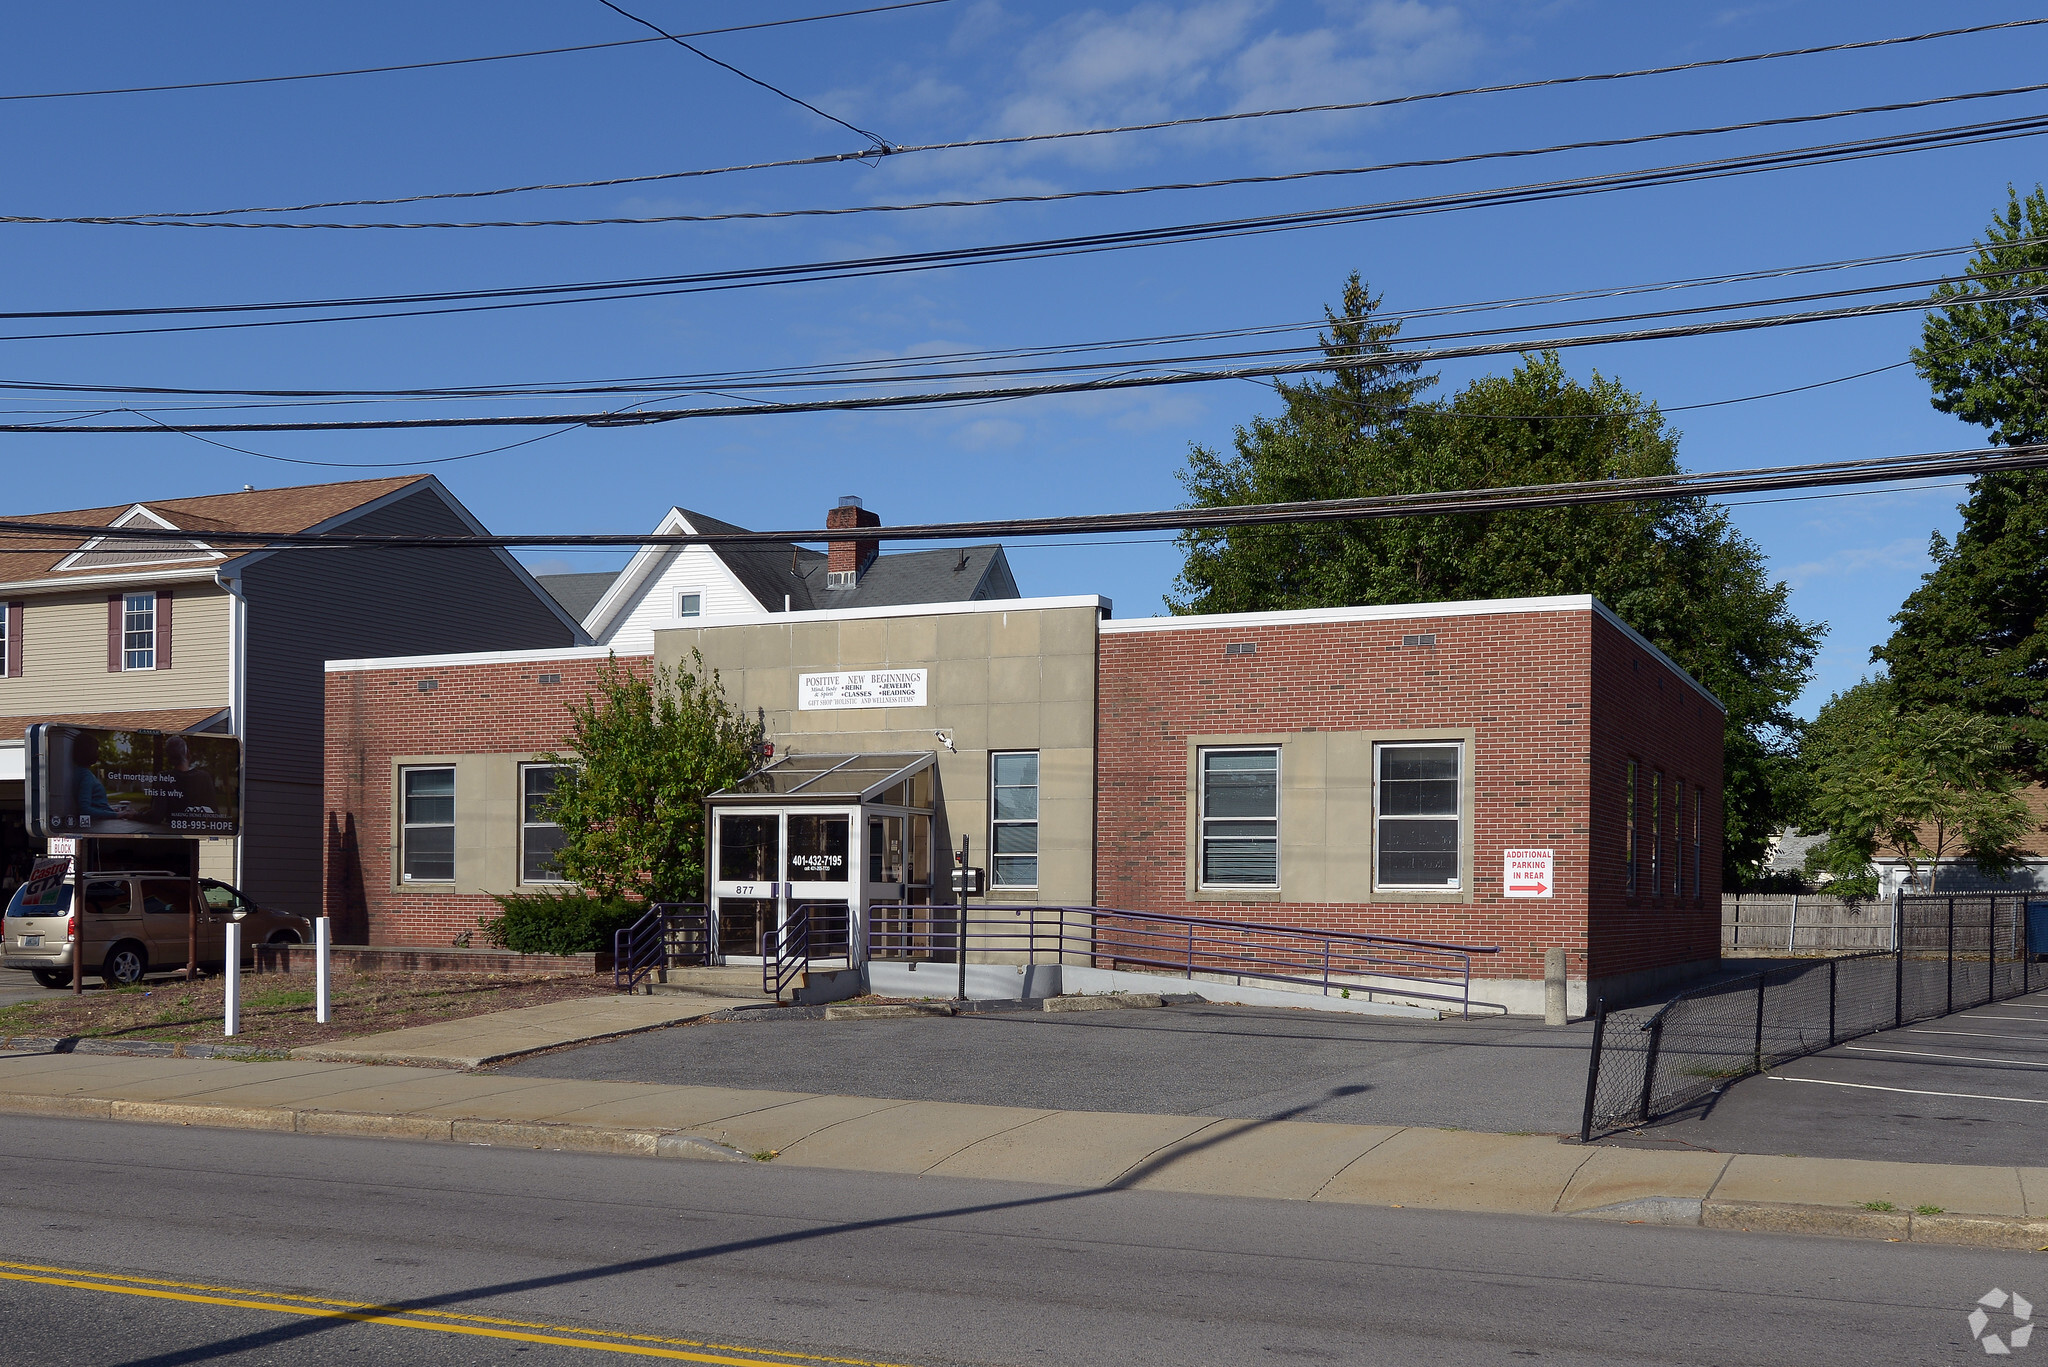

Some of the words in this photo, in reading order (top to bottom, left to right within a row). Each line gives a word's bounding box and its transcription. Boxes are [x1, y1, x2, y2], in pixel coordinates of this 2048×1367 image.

[805, 676, 840, 686] POSITIVE
[848, 675, 865, 684] NEW
[871, 673, 921, 683] BEGINNINGS
[108, 772, 121, 780] Get
[123, 774, 158, 783] mortgage
[159, 774, 177, 783] help.
[144, 788, 159, 797] This
[160, 789, 166, 797] is
[167, 789, 184, 798] why.
[171, 820, 233, 831] 888-995-HOPE
[54, 843, 72, 853] BLOCK
[792, 855, 842, 866] 401-432-7195
[26, 872, 66, 895] GTX
[736, 886, 754, 894] 877
